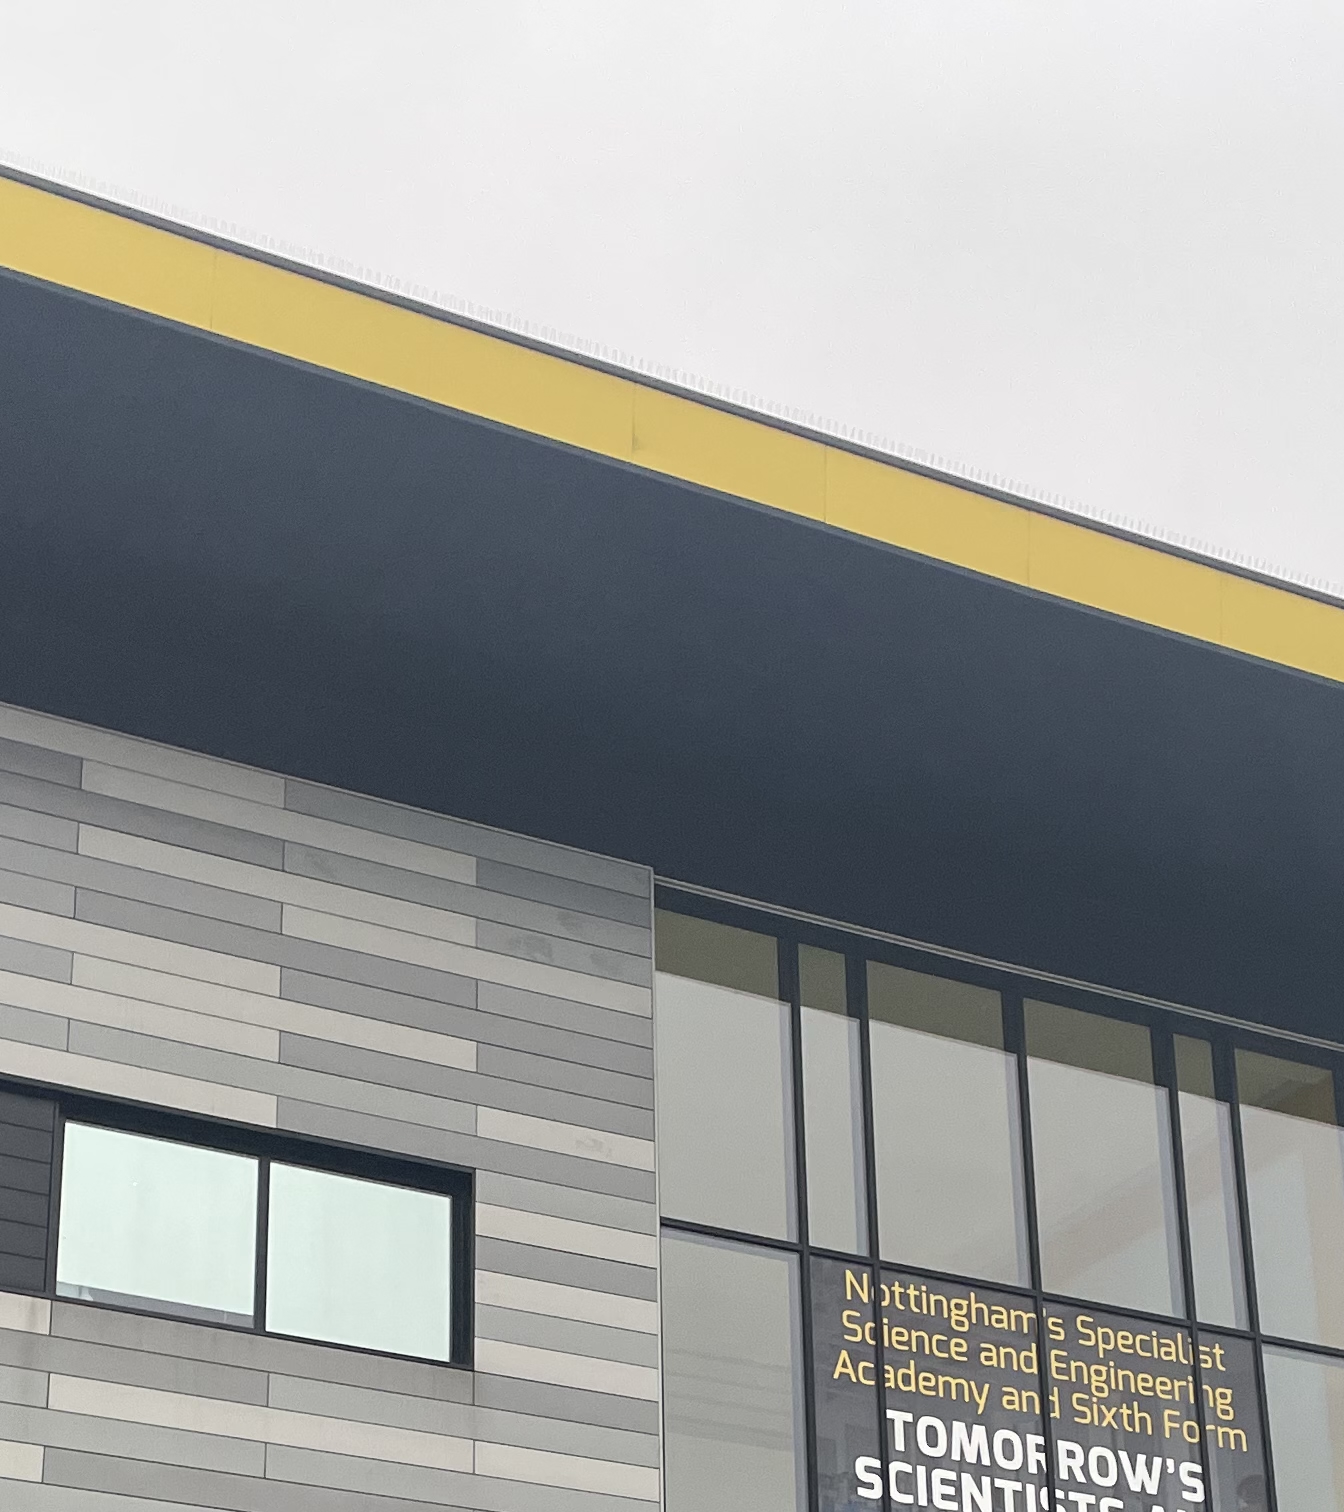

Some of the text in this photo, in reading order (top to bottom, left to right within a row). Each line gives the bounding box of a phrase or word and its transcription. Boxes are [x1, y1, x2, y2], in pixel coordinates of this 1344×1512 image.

[842, 1310, 1235, 1421] Science and Engineering
[844, 1269, 1226, 1371] Nottingham's Specialist
[833, 1349, 990, 1415] Academy
[1001, 1386, 1061, 1420] and
[1071, 1392, 1153, 1436] Sixth
